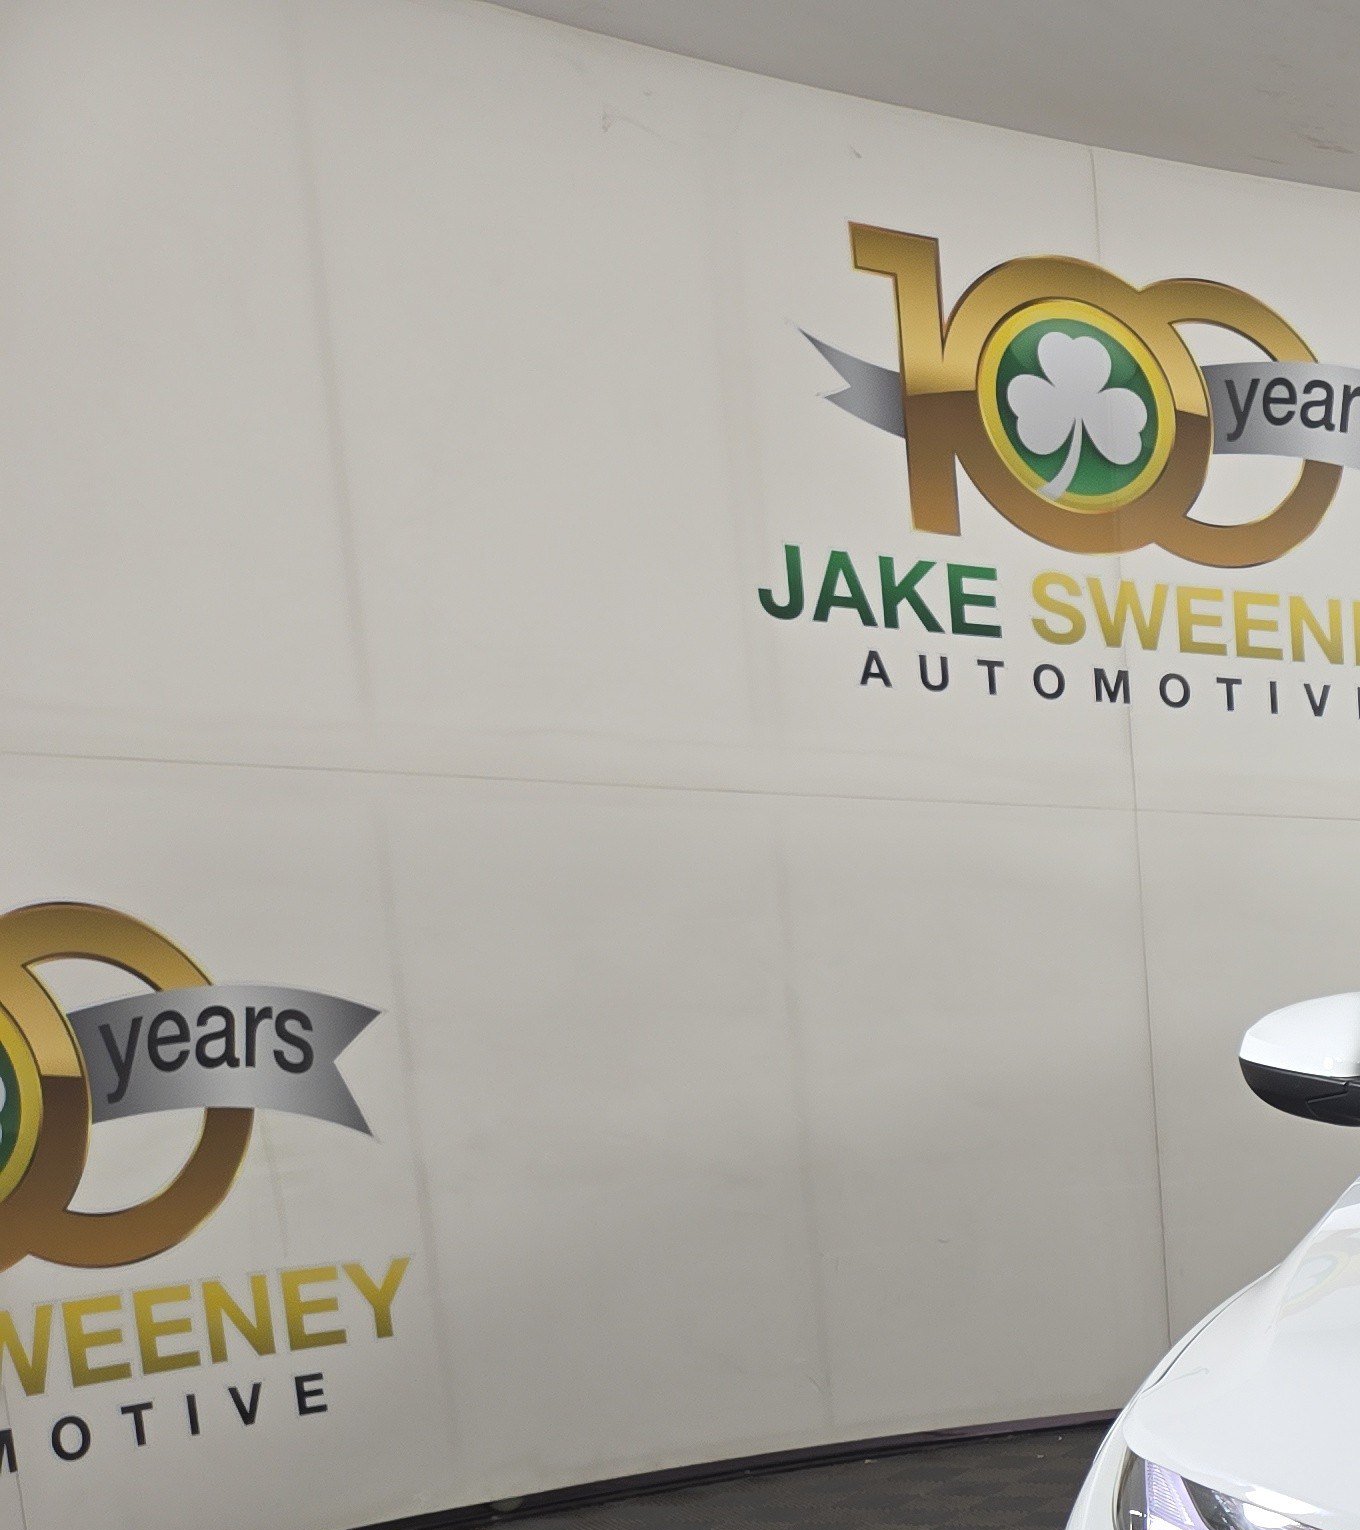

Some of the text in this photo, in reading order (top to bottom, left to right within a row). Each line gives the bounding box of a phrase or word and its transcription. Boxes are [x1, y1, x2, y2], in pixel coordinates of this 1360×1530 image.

[847, 221, 1345, 569] 100
[757, 544, 1003, 640] JAKE
[99, 1004, 315, 1104] years
